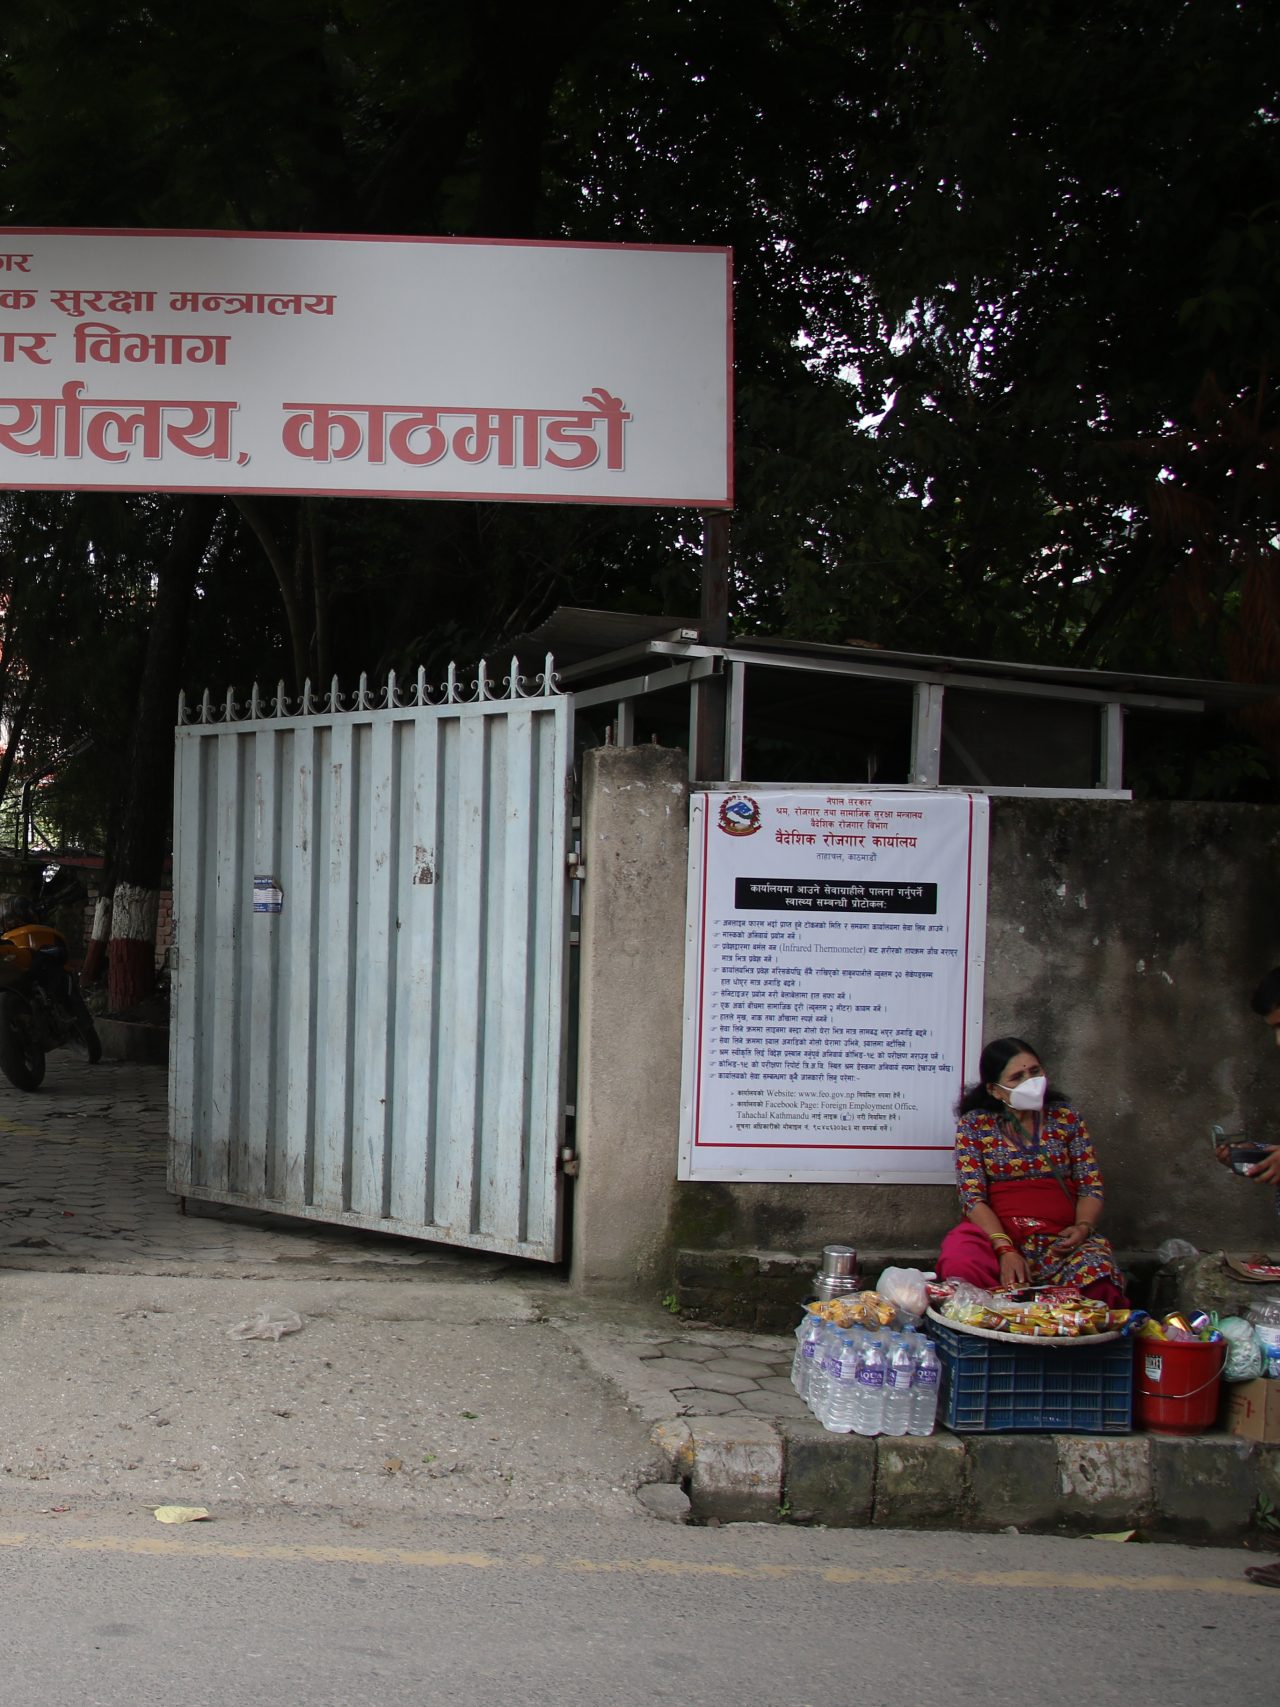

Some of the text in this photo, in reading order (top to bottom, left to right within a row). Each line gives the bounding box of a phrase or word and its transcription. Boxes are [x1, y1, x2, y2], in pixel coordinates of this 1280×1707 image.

[51, 289, 156, 317] सुरक्षा
[169, 291, 336, 316] मन्त्रालय
[74, 321, 231, 366] विभाग
[826, 796, 872, 806] नेपाल सरकार
[775, 807, 789, 816] श्रम,
[794, 806, 820, 816] रोजगार
[839, 807, 871, 817] सामाजिक
[873, 810, 894, 821] सुरक्षा
[896, 811, 923, 819] मन्त्रालय
[810, 817, 888, 829] वैदेशिक रोजगार विभाग
[775, 829, 917, 848] वैदेशिक रोजगार कार्यालय
[749, 881, 923, 899] कार्यालयमा आउने सेवाग्राहीले पालना गर्नुपर्ने
[784, 896, 886, 908] स्वास्थ्य सम्बन्धी प्रोटोकल:
[778, 942, 811, 953] (Infrared
[815, 943, 866, 955] Thermometer)
[766, 1089, 796, 1097] Website:
[797, 1090, 855, 1100] www.feo.gov.np
[765, 1100, 798, 1108] Facebook
[799, 1100, 819, 1110] Page:
[820, 1101, 847, 1111] Foreign
[848, 1101, 893, 1111] Employment
[893, 1102, 920, 1111] Office,
[737, 1110, 767, 1118] Tahachal
[769, 1111, 809, 1119] Kathmandu
